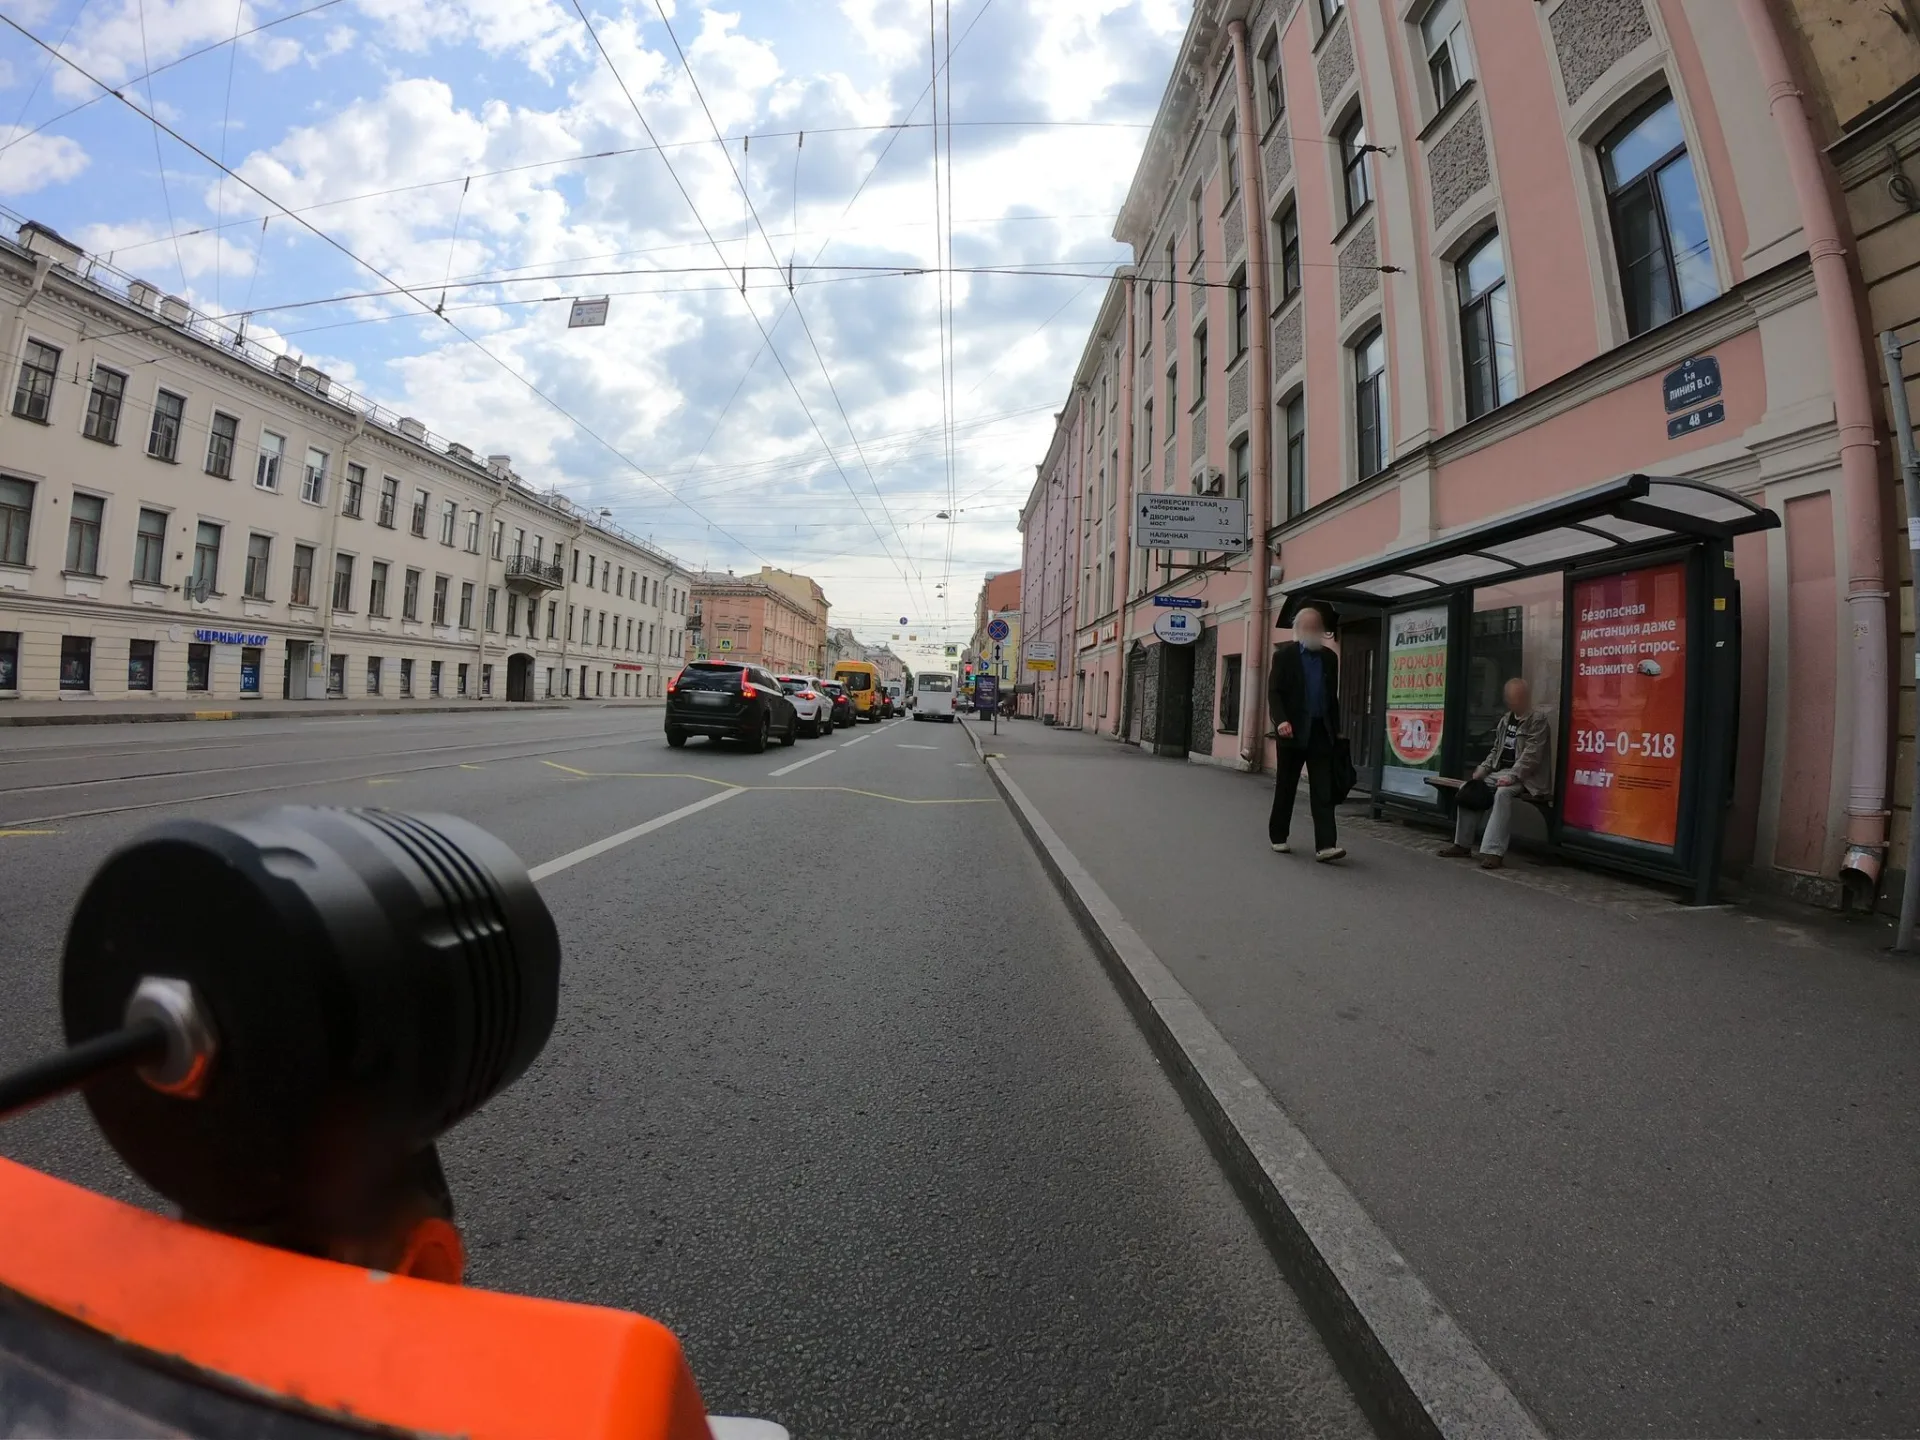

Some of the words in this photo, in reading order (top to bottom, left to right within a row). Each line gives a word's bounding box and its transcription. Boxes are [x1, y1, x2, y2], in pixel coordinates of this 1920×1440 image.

[1669, 382, 1695, 400] ЛИНИЯ
[1689, 413, 1700, 426] 48
[1149, 498, 1218, 508] УНИВЕРСИТЕТСКАЯ
[1149, 513, 1195, 522] ДВОРЦОВЫЙ
[1149, 531, 1189, 539] НАЛИЧНАЯ
[1581, 603, 1646, 622] Безопасная
[195, 629, 245, 644] ЧЕРНЫЙ
[247, 634, 268, 646] КОТ
[1580, 624, 1640, 642] дистанция
[1642, 618, 1677, 636] даже
[1580, 648, 1586, 658] в
[1587, 640, 1637, 657] высокий
[1639, 639, 1680, 656] спрос.
[1393, 652, 1444, 671] УРОЖАЙ
[1579, 663, 1634, 676] Закажите
[1392, 671, 1444, 691] СКИДОК
[1576, 729, 1676, 758] 318-0-318
